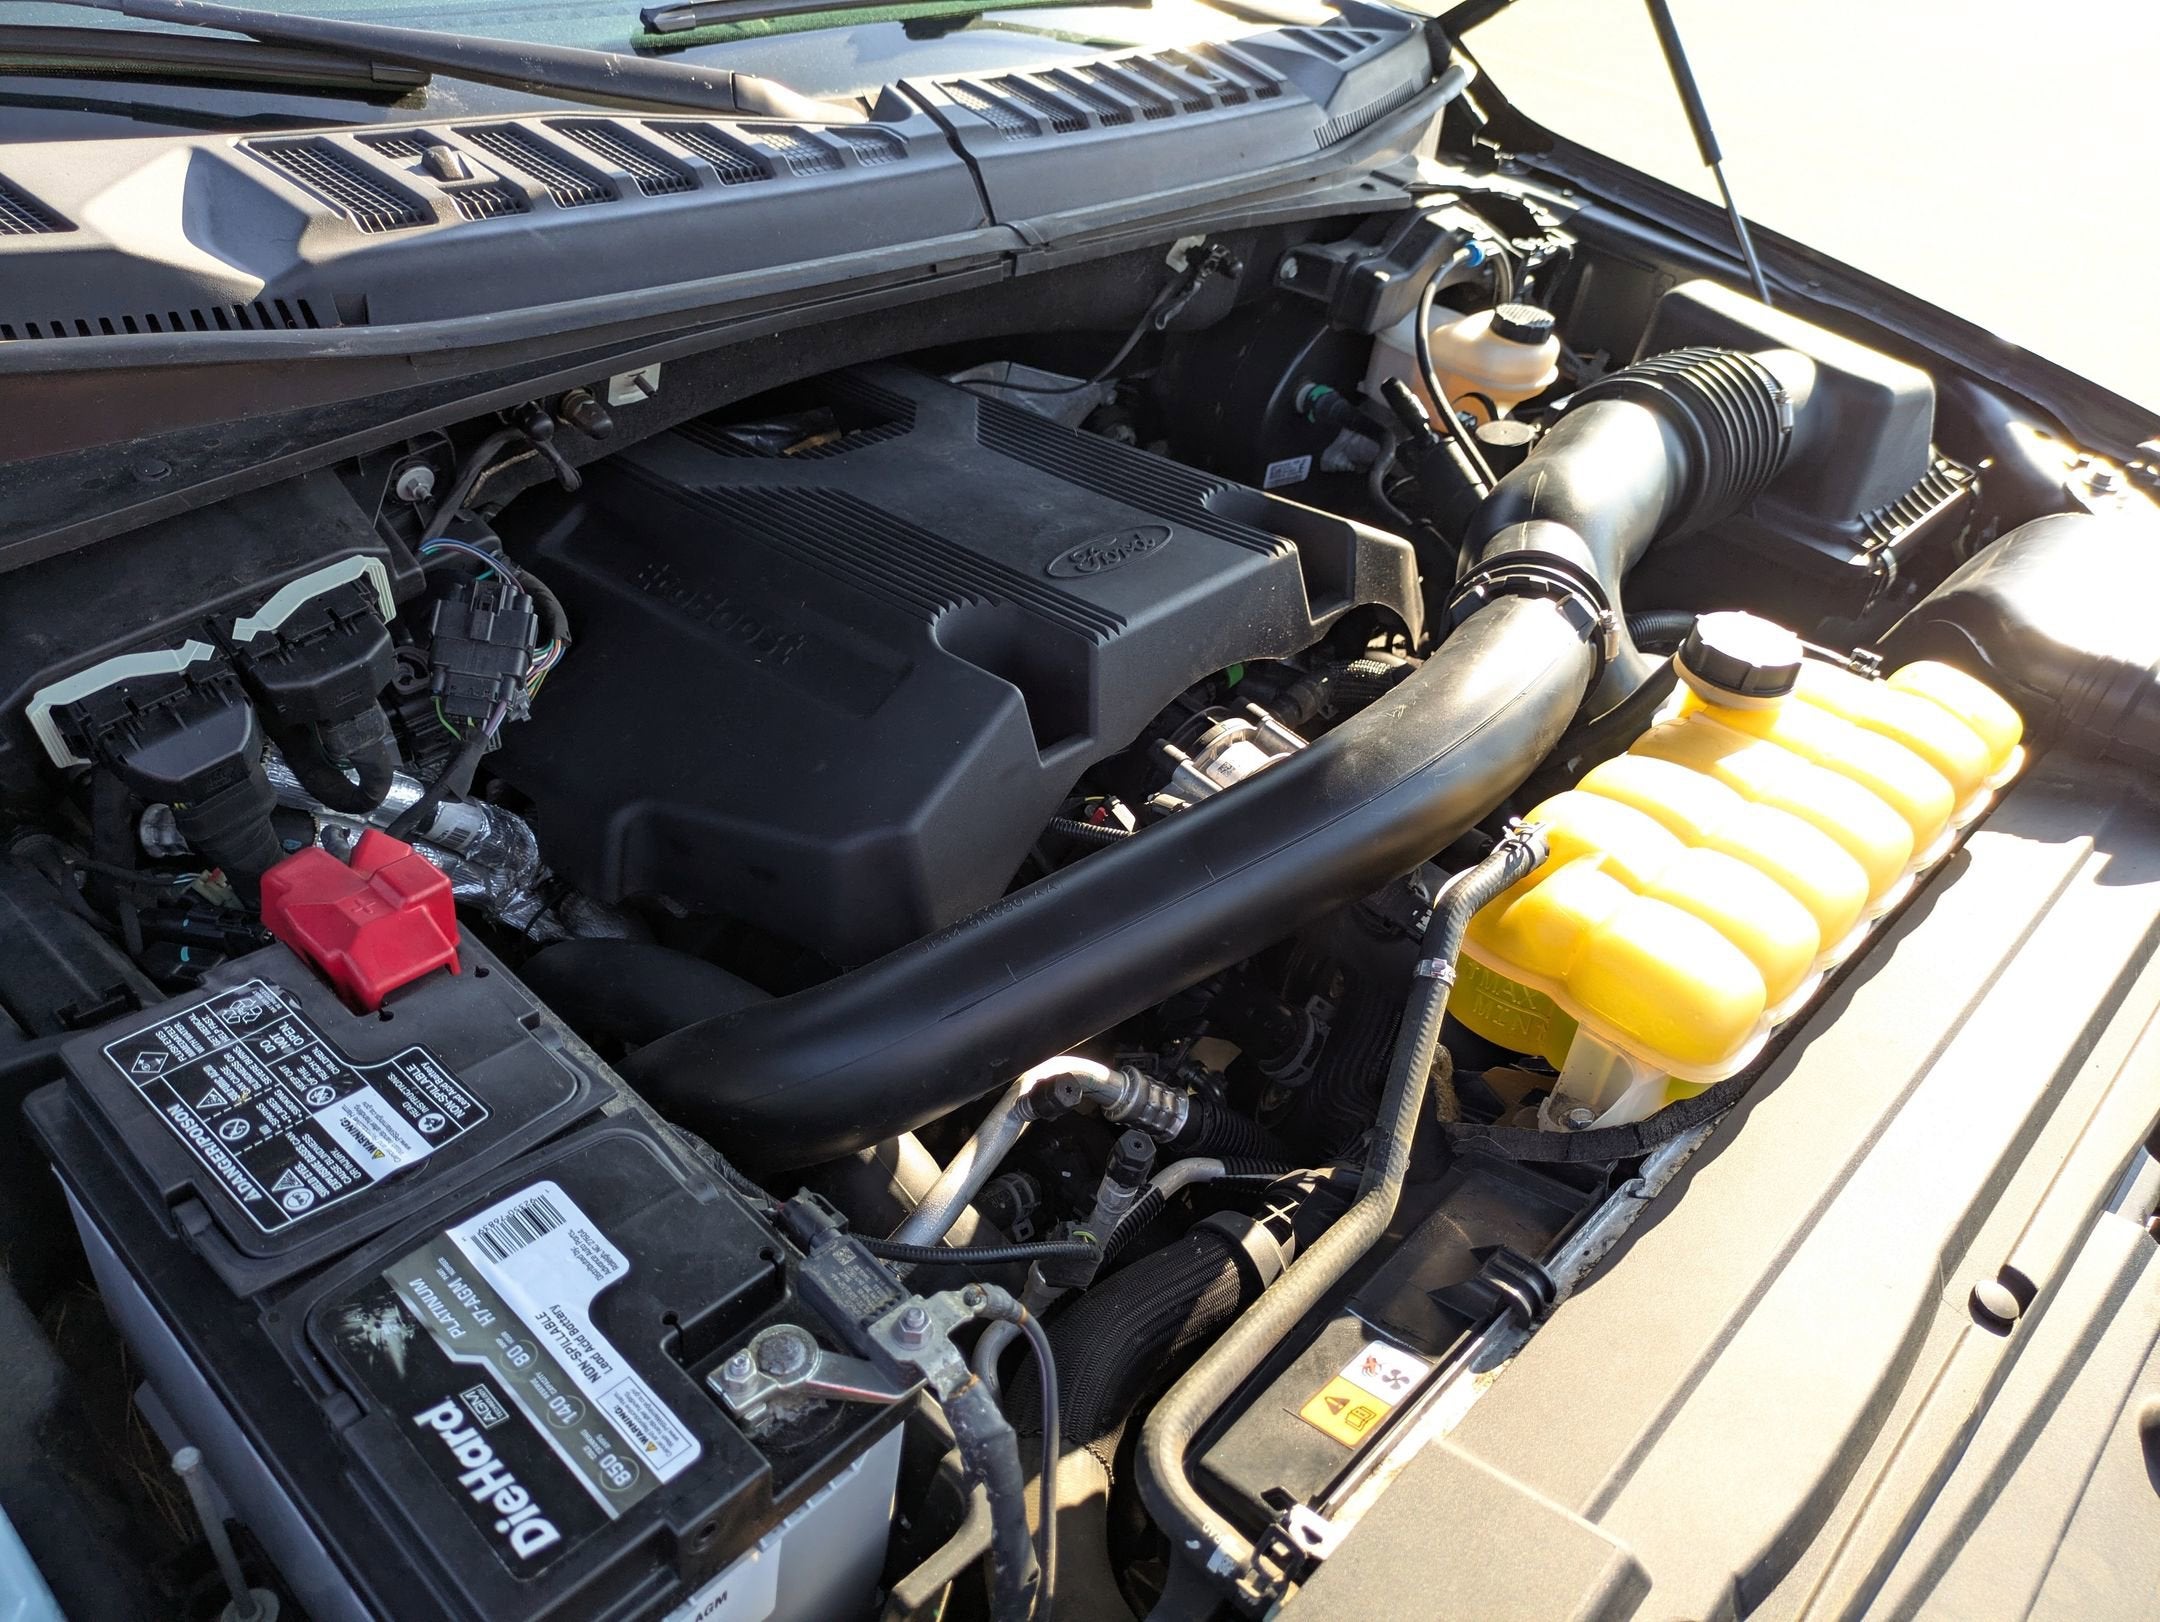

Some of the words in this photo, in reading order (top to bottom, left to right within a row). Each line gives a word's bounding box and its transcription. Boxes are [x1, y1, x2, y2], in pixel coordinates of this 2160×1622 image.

[1069, 533, 1155, 573] Ford
[185, 1012, 213, 1036] MEDICAL
[200, 1014, 218, 1029] FAST.
[1472, 992, 1531, 1035] MIN
[154, 1030, 172, 1045] EYES
[162, 1024, 197, 1057] IMMEDIATELY
[171, 1021, 194, 1040] WATER.
[206, 1034, 222, 1046] GET
[213, 1027, 230, 1042] HELP
[268, 1031, 291, 1049] NOT
[275, 1021, 306, 1046] OPEN.
[166, 1043, 187, 1061] FLUSH
[188, 1038, 206, 1053] WITH
[230, 1044, 254, 1064] BURNS.
[258, 1039, 276, 1052] DO
[222, 1052, 236, 1062] OR
[300, 1052, 313, 1062] OF
[309, 1046, 343, 1074] CHILDREN.
[201, 1064, 220, 1078] ACID
[219, 1064, 241, 1084] CAUSE
[230, 1060, 263, 1089] BLINDNESS
[248, 1063, 273, 1084] SEVERE
[278, 1064, 294, 1076] OUT
[307, 1061, 330, 1080] REACH
[417, 1061, 447, 1084] Battery
[213, 1076, 241, 1101] SULFURIC
[235, 1081, 252, 1095] CAN
[289, 1075, 308, 1090] KEEP
[384, 1071, 430, 1112] INSTRUCTIONS.
[404, 1062, 466, 1118] NON-SPILLABLE
[439, 1082, 457, 1095] Acid
[400, 1100, 421, 1117] READ
[452, 1093, 472, 1109] Lead
[283, 1131, 301, 1146] CAN
[336, 1116, 378, 1153] WARNING:
[165, 1102, 254, 1193] DANGER/POISON
[294, 1143, 317, 1163] GASES
[300, 1132, 336, 1165] BLINDNESS
[328, 1147, 354, 1169] INJURY.
[291, 1160, 313, 1179] EYES.
[309, 1159, 343, 1190] EXPLOSIVE
[329, 1163, 353, 1184] CAUSE
[348, 1167, 363, 1178] OR
[306, 1176, 331, 1198] SHIELD
[578, 1243, 593, 1256] Auto
[588, 1254, 611, 1276] Advance
[407, 1277, 467, 1338] PLATINUM
[446, 1277, 497, 1327] H7-AGM
[547, 1303, 581, 1335] Battery
[534, 1310, 602, 1383] NON-SPILLABLE
[573, 1334, 595, 1353] Acid
[504, 1344, 532, 1367] 80
[590, 1352, 613, 1373] Lead
[463, 1389, 498, 1423] AGM
[546, 1394, 580, 1424] 140
[611, 1404, 650, 1444] WARNING:
[411, 1398, 564, 1559] DieHard
[596, 1452, 634, 1486] 850
[695, 1590, 728, 1622] AGM
